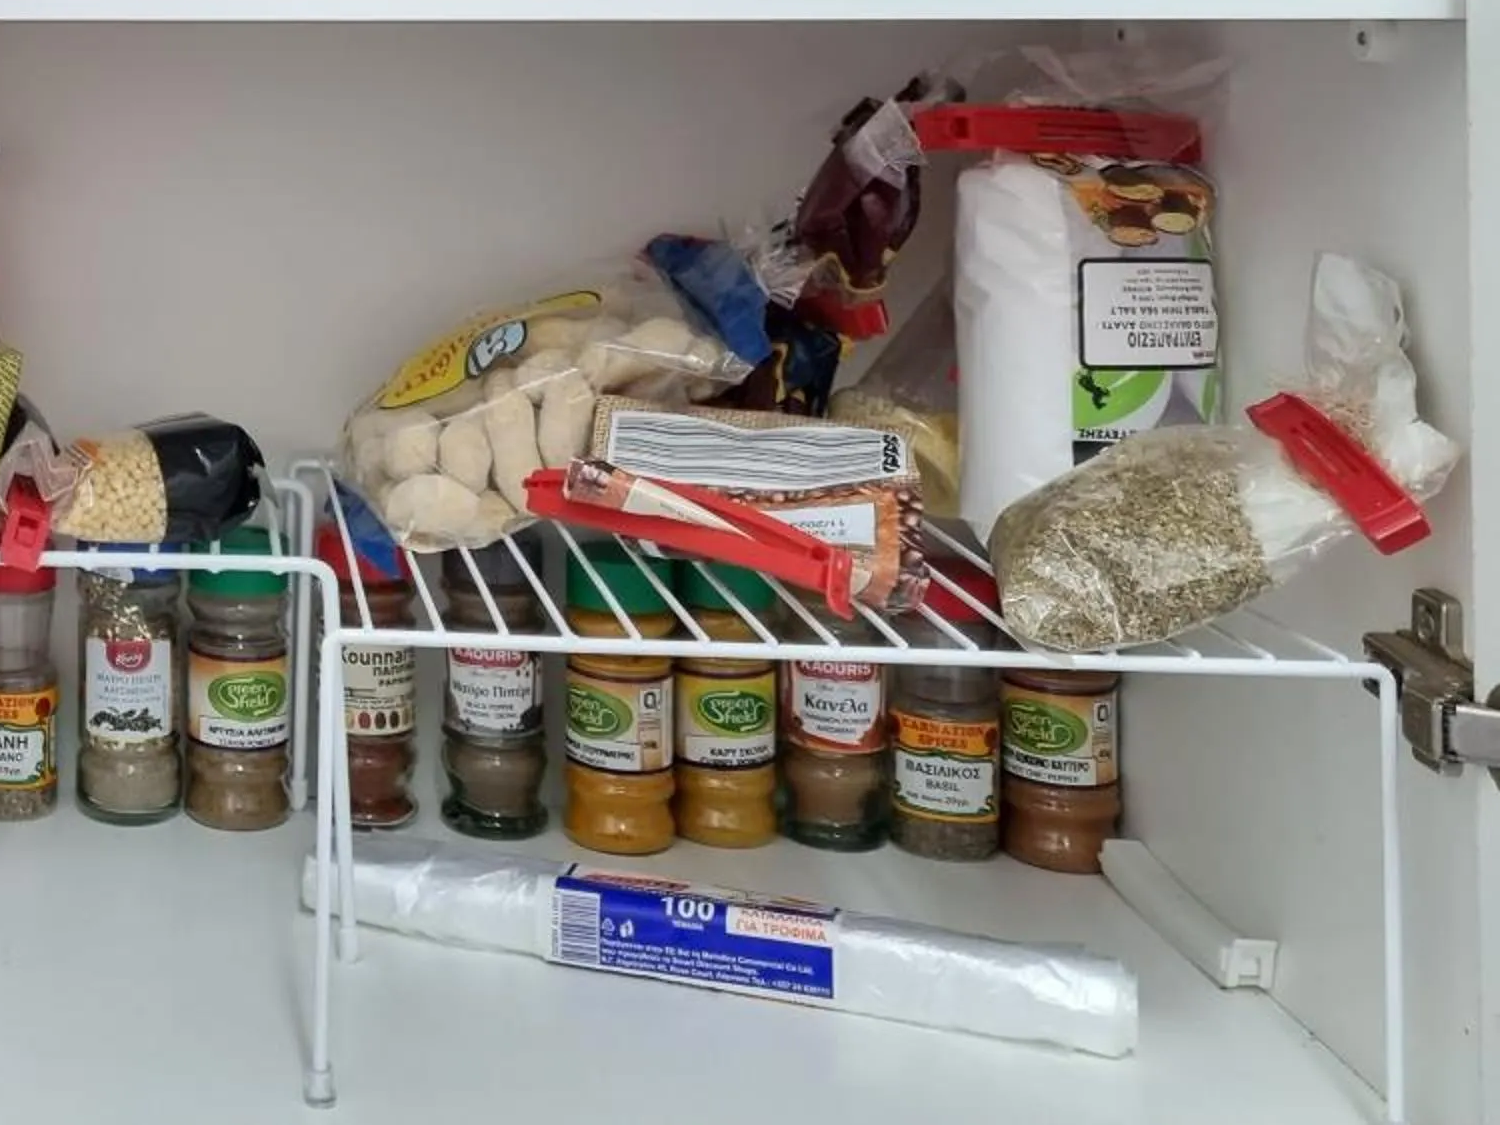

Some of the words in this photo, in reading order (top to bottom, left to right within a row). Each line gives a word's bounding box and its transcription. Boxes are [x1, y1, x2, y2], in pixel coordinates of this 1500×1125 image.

[904, 759, 982, 782] ΒΑΣΙΛΙΚΟΣ
[925, 778, 960, 793] BASIL
[661, 895, 715, 922] 100
[763, 923, 828, 942] ΤΡΟΦΙΜΑ
